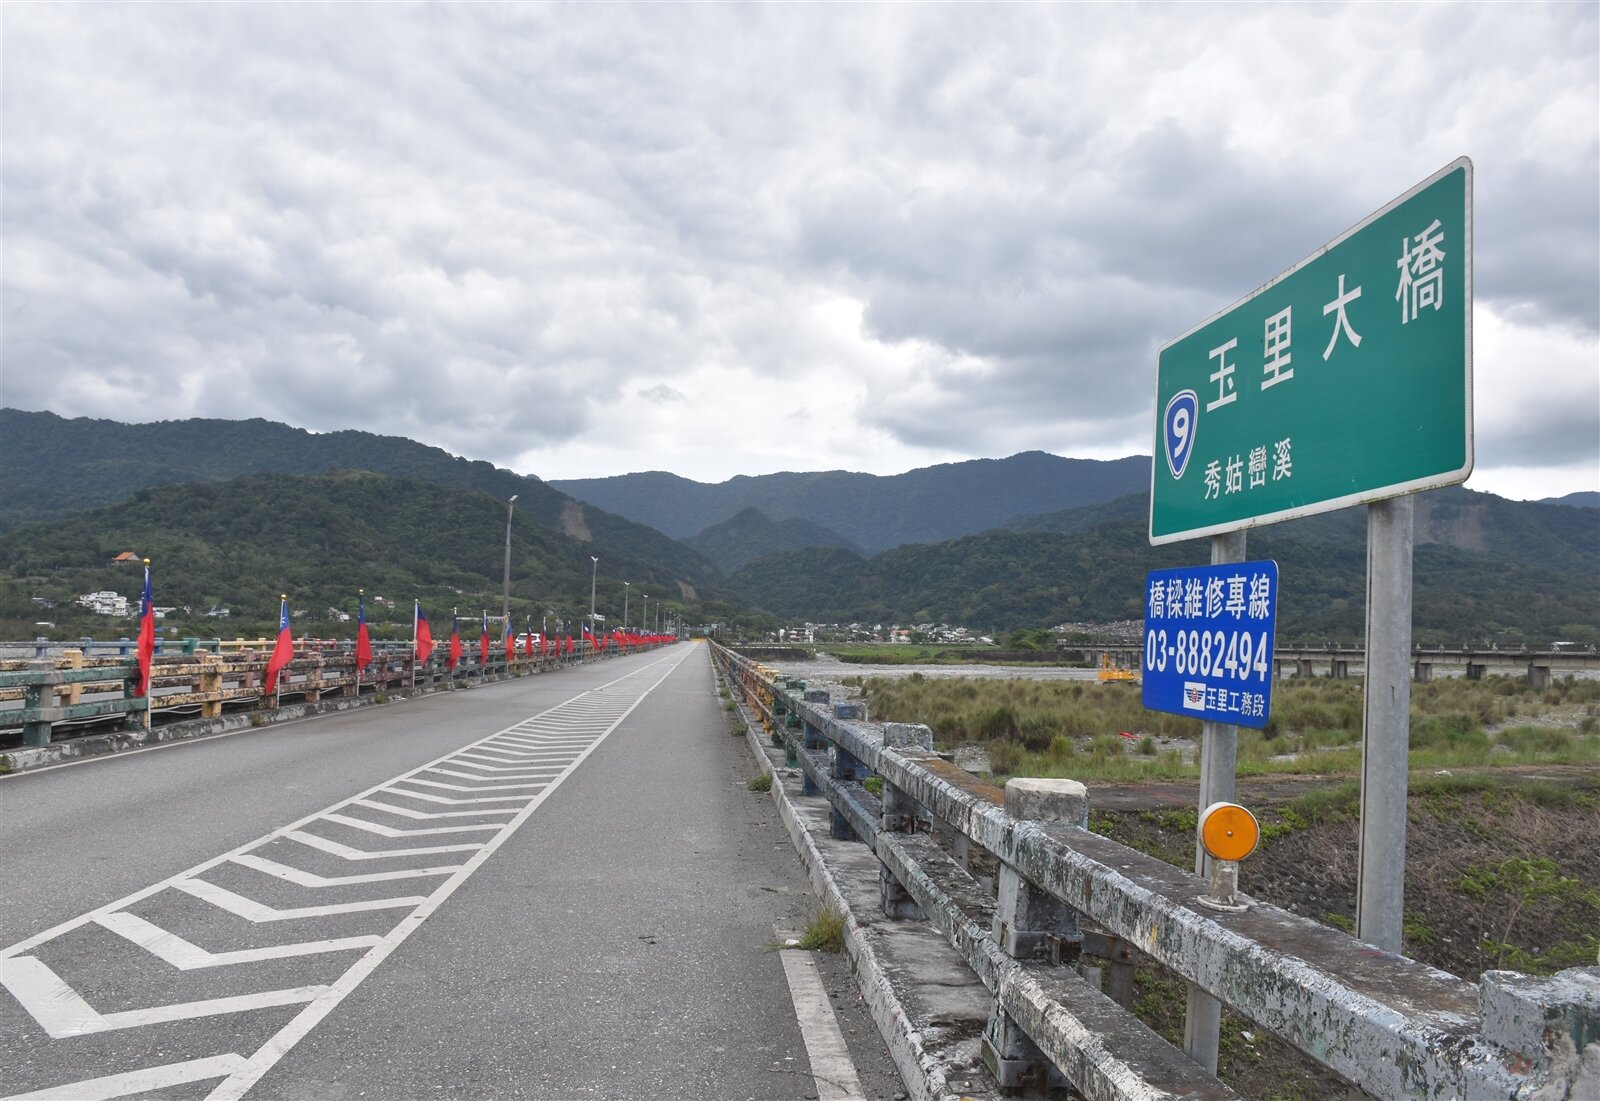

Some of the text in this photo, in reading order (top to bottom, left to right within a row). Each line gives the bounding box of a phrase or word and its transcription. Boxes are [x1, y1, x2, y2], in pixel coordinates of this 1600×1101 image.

[1206, 219, 1446, 413] 玉里大橋
[1173, 407, 1190, 459] 9
[1204, 437, 1293, 500] 秀姑巒溪
[1149, 573, 1270, 620] 橋樑維修專線
[1146, 629, 1267, 682] 03-8882494
[1205, 687, 1265, 718] 玉里工務段
